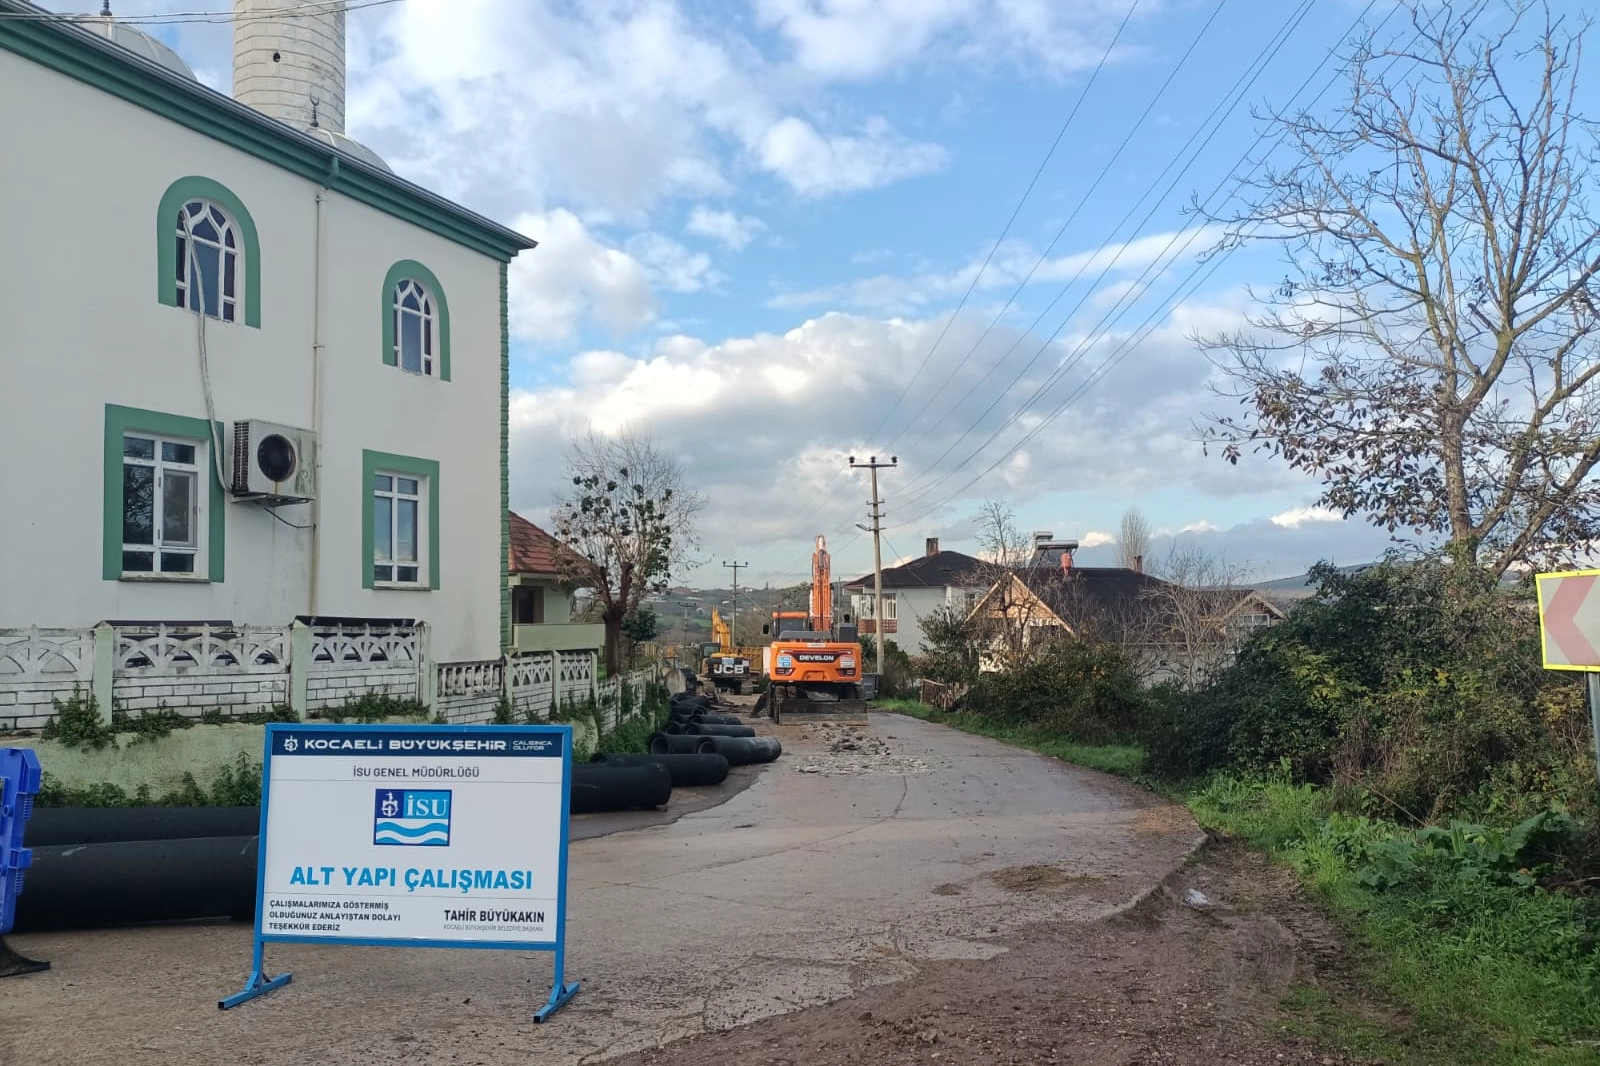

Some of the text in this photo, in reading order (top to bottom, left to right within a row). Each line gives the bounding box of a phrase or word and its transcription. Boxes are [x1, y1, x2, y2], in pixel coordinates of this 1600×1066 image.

[713, 664, 744, 674] JCB
[353, 766, 480, 778] İSU GENEL MÜDÜRLÜĞÜ
[406, 794, 448, 816] İSU
[289, 866, 533, 893] ALT YAPI ÇALIŞMASI
[269, 899, 389, 911] ÇALIŞMALARIMIZA GÖSTERMİŞ
[269, 910, 401, 921] OLDUĞUNUZ ANLAYIŞTAN DOLAYI
[443, 907, 545, 922] TAHİR BÜYÜKAKIN
[268, 921, 341, 931] TEŞEKKÜR EDERİZ
